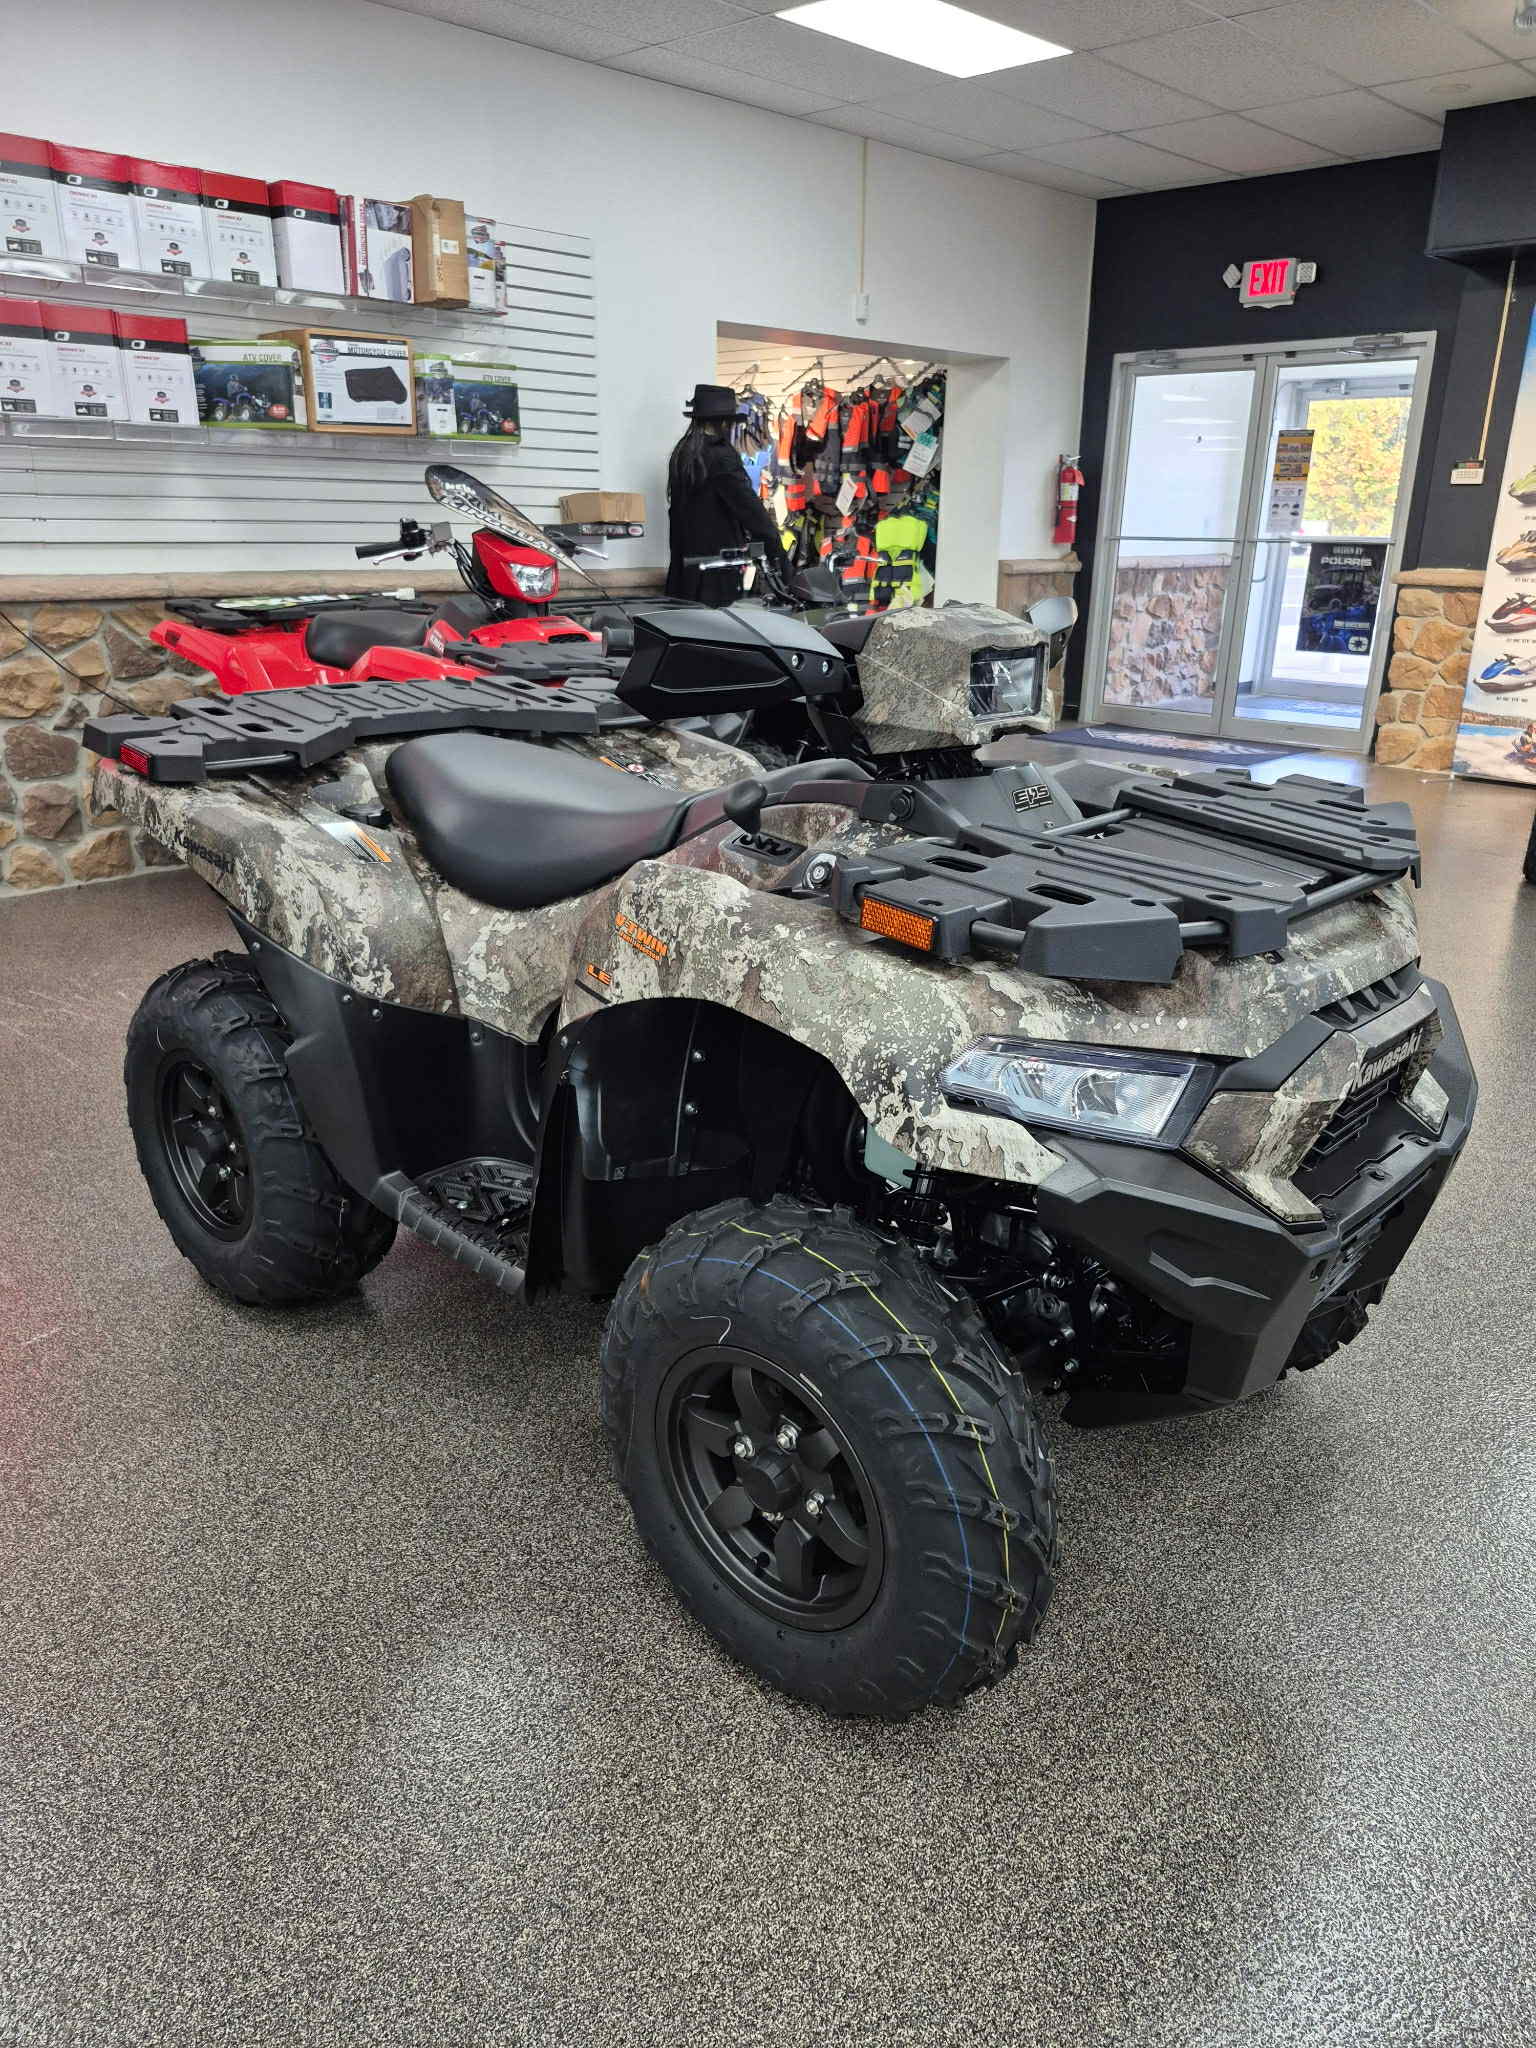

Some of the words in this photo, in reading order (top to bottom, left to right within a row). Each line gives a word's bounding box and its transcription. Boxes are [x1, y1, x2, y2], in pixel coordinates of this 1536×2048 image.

[1248, 260, 1289, 297] EXIT
[243, 353, 257, 361] ATV
[258, 353, 282, 362] COVER
[1320, 556, 1373, 567] POLARIS
[174, 827, 234, 874] Kawasaki
[586, 963, 612, 986] LE
[1351, 1028, 1424, 1094] Kawasaki
